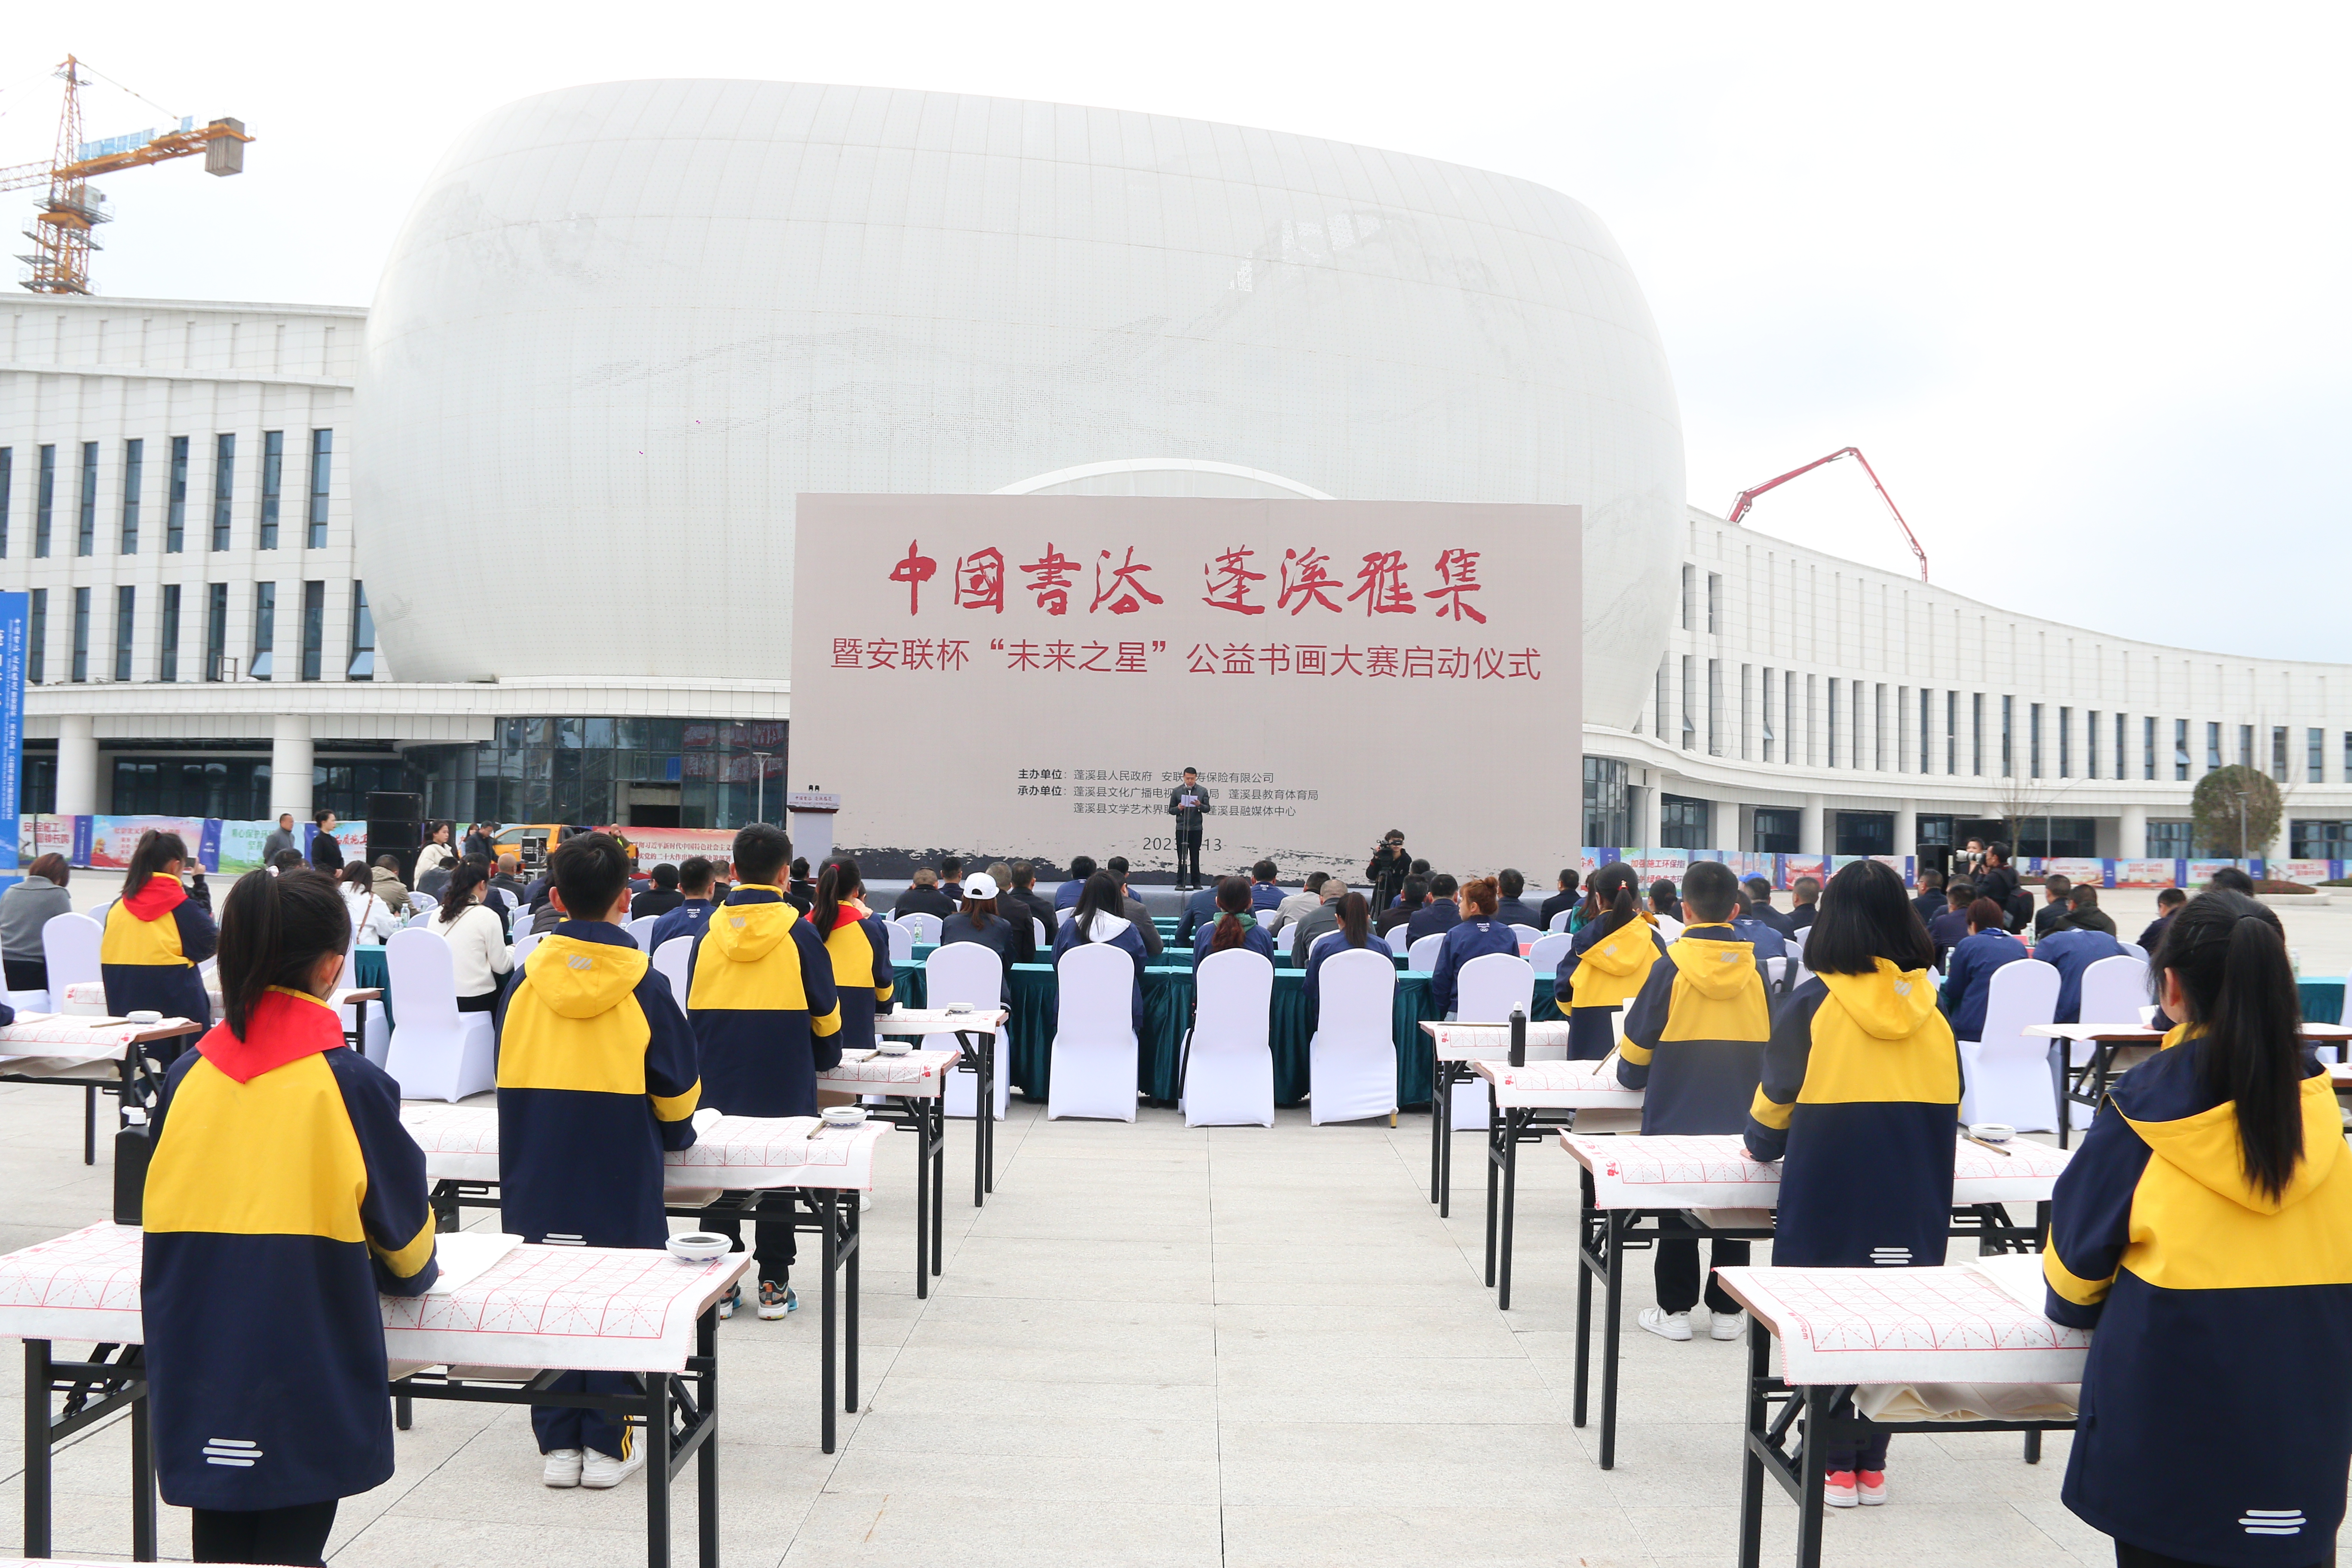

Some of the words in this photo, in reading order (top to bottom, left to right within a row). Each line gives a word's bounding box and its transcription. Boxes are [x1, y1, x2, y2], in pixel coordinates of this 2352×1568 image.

[1202, 545, 1486, 624] 蓬溪雅集
[1161, 771, 1274, 784] 安联寿保险有限公司
[1074, 786, 1219, 799] 蓬溪县文化广播电视局
[1228, 789, 1318, 801] 蓬溪县教育体育局
